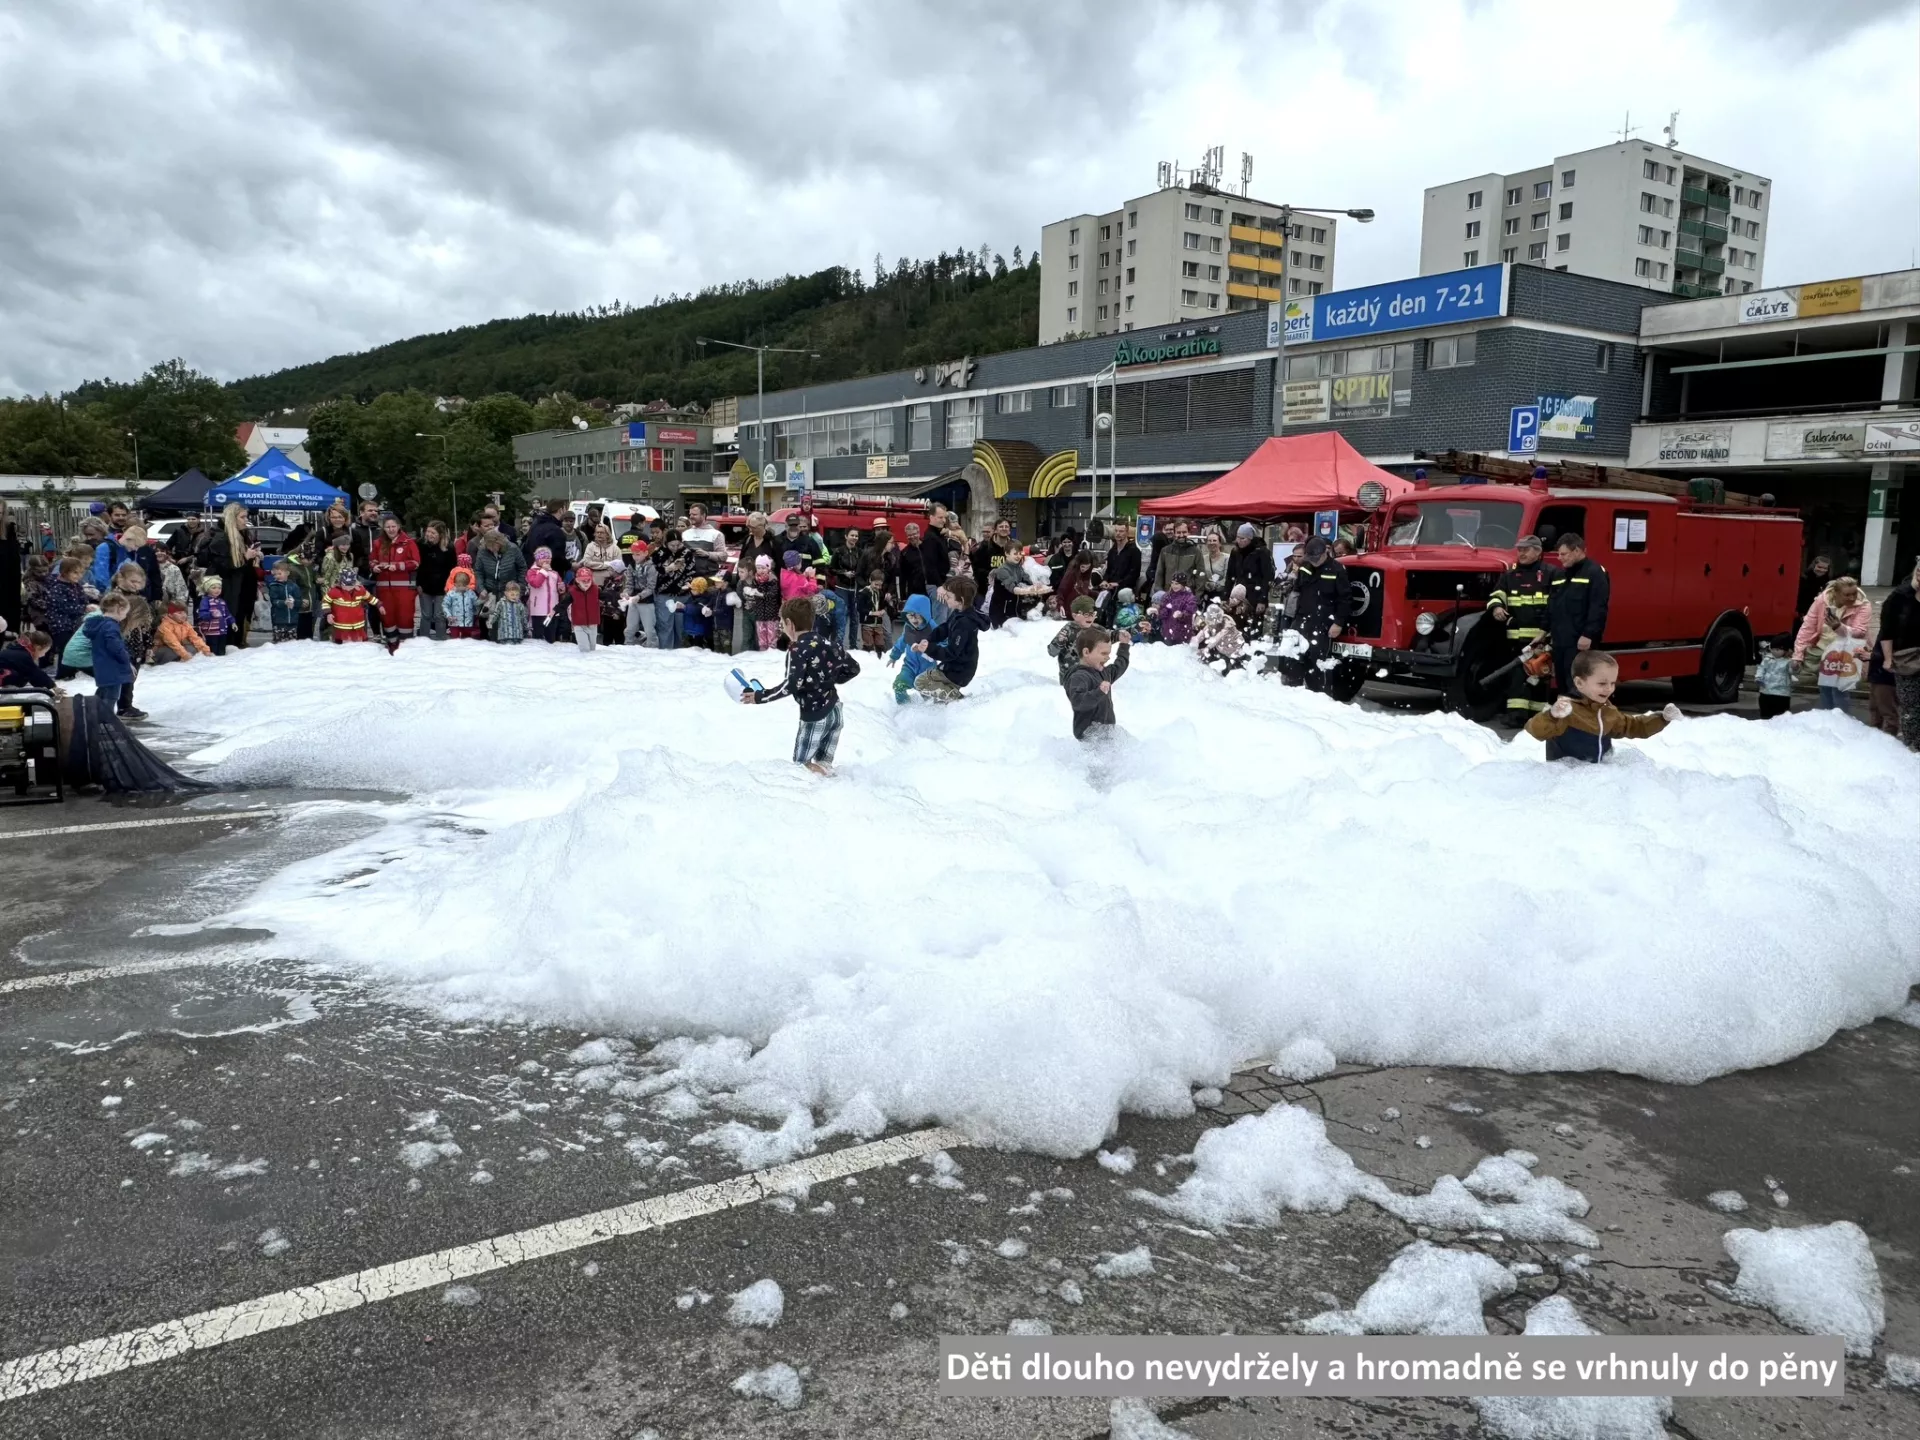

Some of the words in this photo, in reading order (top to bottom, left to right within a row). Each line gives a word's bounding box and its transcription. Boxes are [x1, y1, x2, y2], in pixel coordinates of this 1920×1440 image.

[1326, 296, 1382, 327] každý
[1388, 294, 1426, 317] den
[1436, 282, 1485, 312] 7-21
[1132, 338, 1219, 363] Kooperativa
[1333, 375, 1390, 401] OPTIK
[1554, 398, 1595, 418] FASHION
[1516, 412, 1534, 438] P
[1660, 449, 1698, 460] SECOND
[1701, 448, 1729, 459] HAND
[1824, 660, 1852, 672] teta
